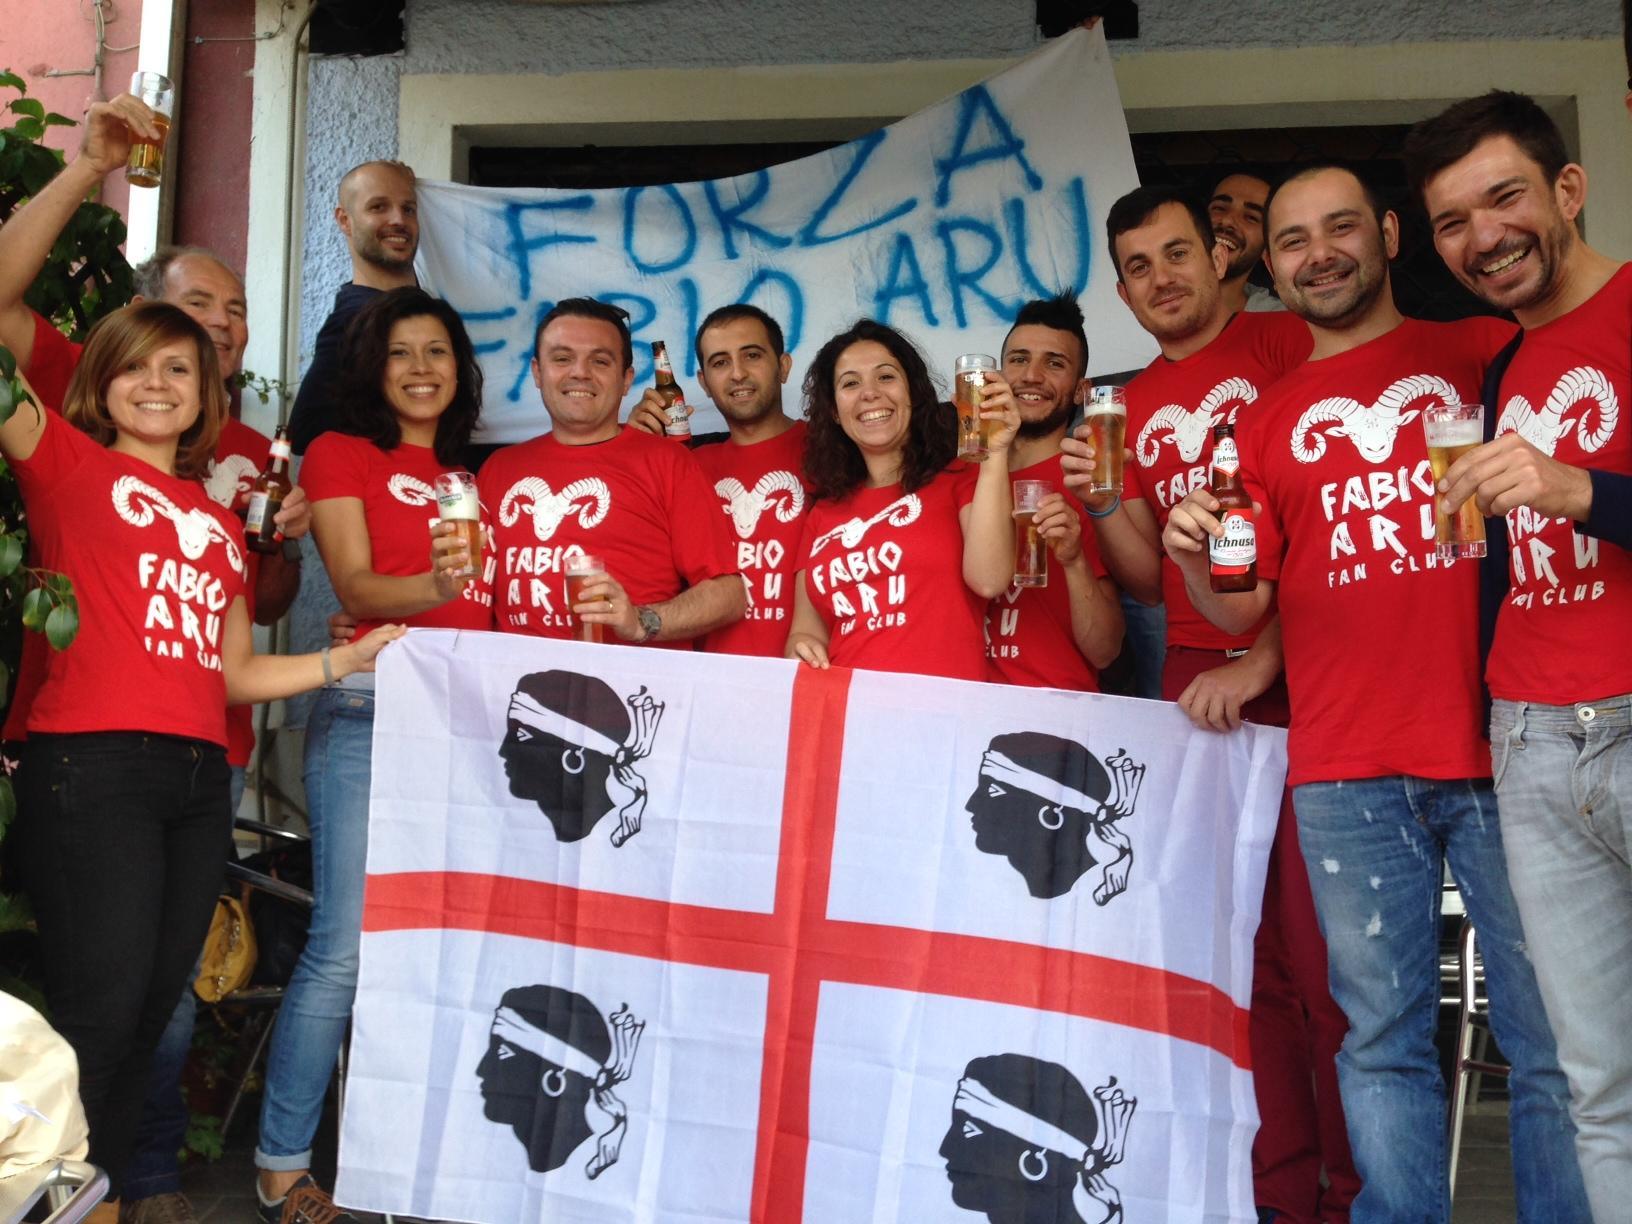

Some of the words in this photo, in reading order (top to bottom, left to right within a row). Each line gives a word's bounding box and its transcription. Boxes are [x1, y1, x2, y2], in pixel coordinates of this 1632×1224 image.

[506, 85, 1043, 300] FORZA
[873, 176, 1092, 330] ARU
[1155, 461, 1213, 508] FAB
[1321, 460, 1435, 522] FABIO
[737, 539, 784, 569] BIO
[812, 541, 902, 595] FABIO
[1513, 528, 1599, 588] ARU
[138, 552, 227, 612] FABIO
[740, 572, 782, 608] RU
[1328, 563, 1366, 588] FAN
[1543, 581, 1605, 606] CLUB
[462, 587, 492, 608] CLU
[507, 578, 569, 615] AR
[744, 607, 784, 620] CLUB
[831, 574, 905, 618] ARU
[144, 595, 220, 649] ARU
[542, 614, 573, 627] CL
[866, 612, 906, 631] CLUB
[144, 637, 183, 659] FAN
